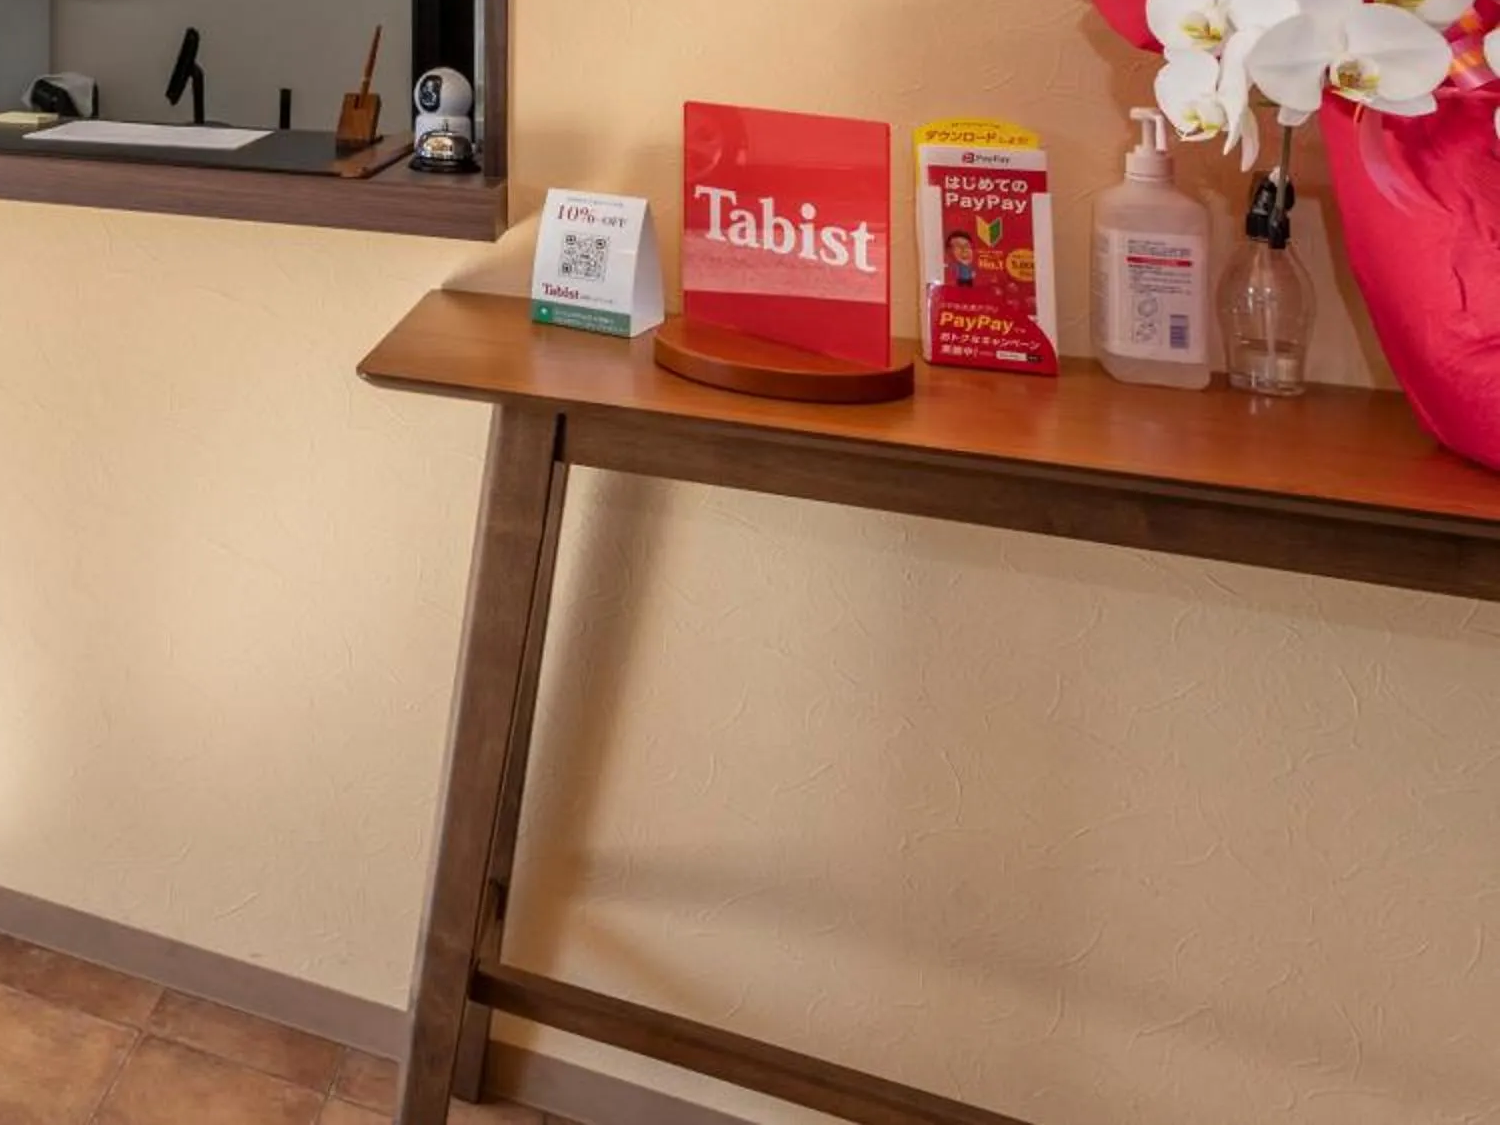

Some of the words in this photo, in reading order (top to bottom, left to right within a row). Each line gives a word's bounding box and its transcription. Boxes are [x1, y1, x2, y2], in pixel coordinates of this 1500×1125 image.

[944, 175, 1029, 193] はじめての
[557, 204, 596, 224] 10%
[944, 192, 1027, 214] PayPay
[694, 185, 877, 272] Tabist
[940, 311, 1014, 335] PayPay
